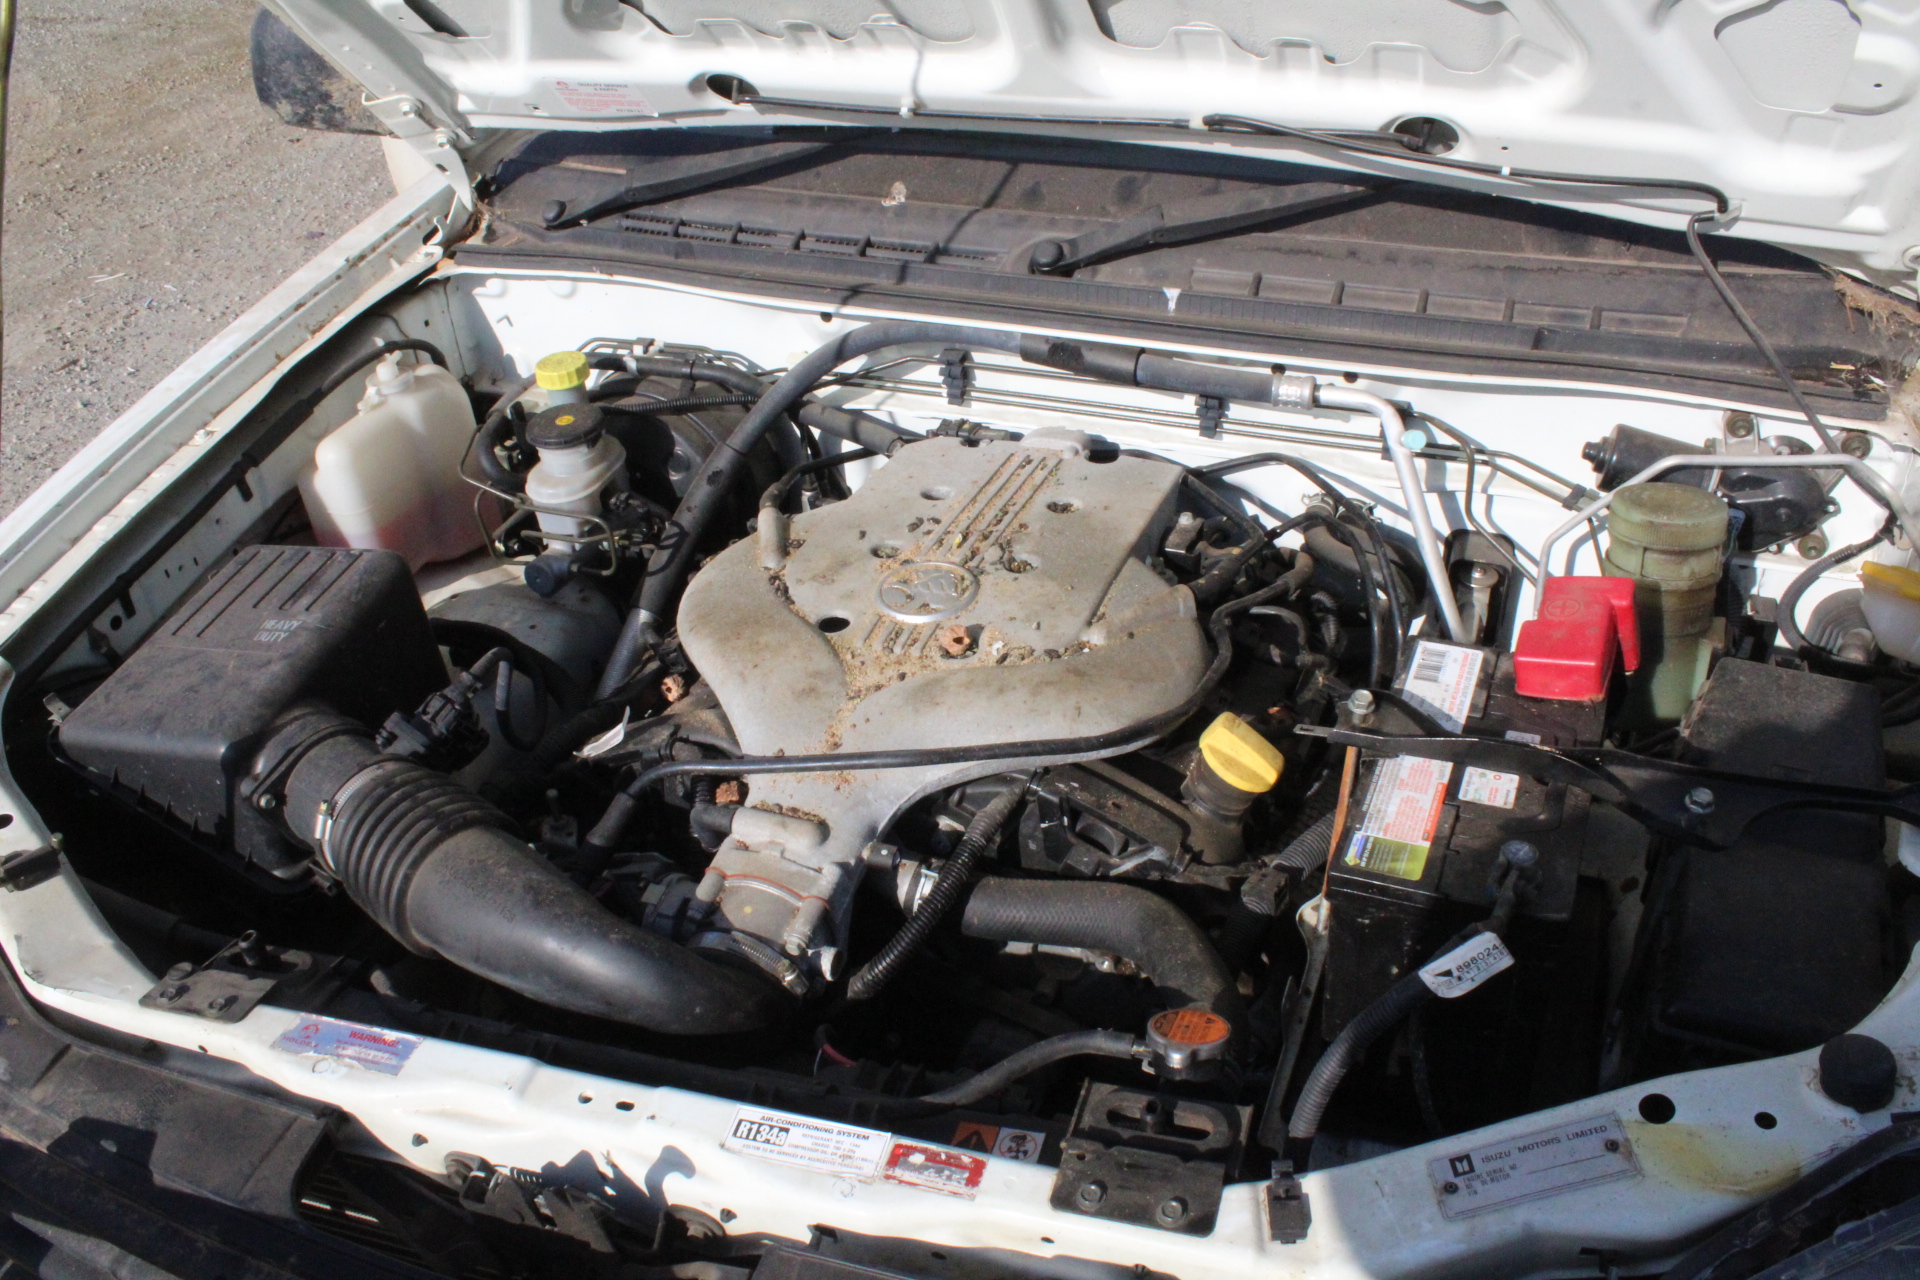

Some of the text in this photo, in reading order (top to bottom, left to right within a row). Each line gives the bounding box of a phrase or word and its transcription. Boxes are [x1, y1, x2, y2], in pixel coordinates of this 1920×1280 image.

[253, 631, 290, 642] DUTY
[260, 619, 303, 631] HEAVY
[1456, 944, 1499, 973] 898024
[349, 1030, 400, 1048] WARNING!
[735, 1120, 788, 1146] R134a
[760, 1115, 870, 1141] AIR-CONDITIONING SYSTEM
[1481, 1125, 1608, 1163] ISUZU MOTORS LIMITED
